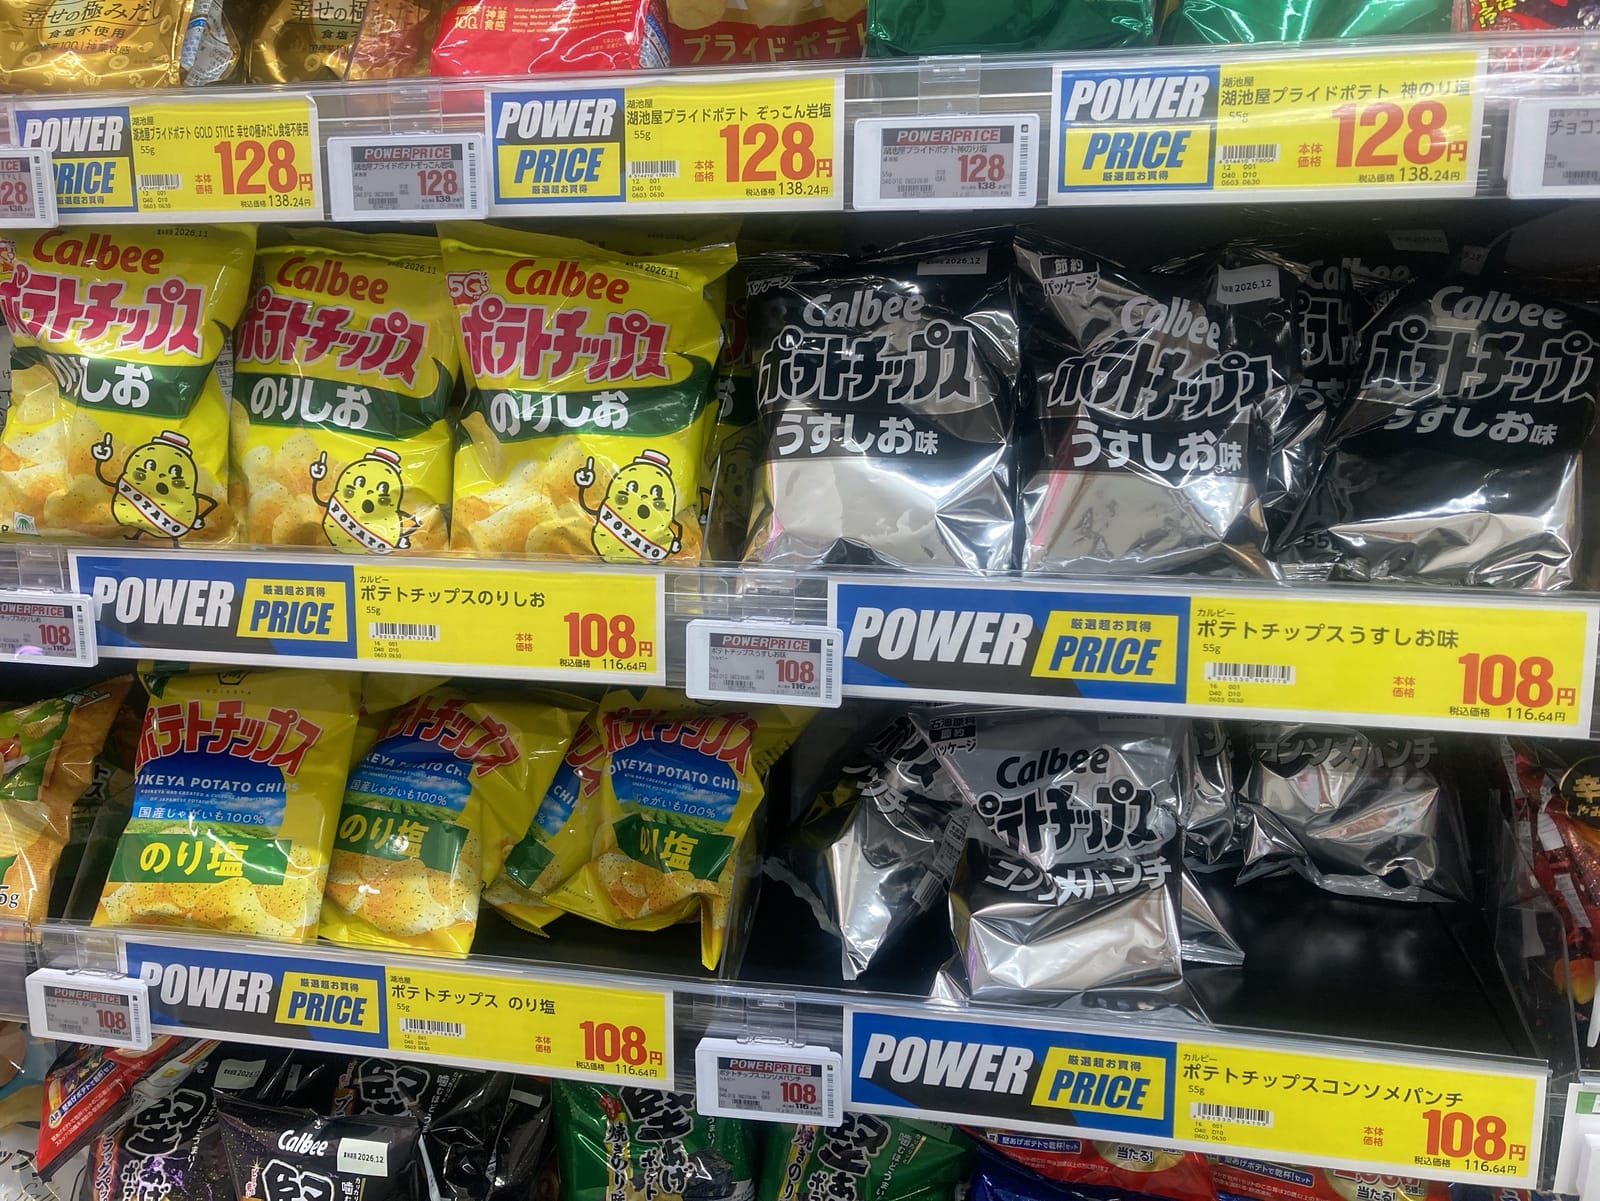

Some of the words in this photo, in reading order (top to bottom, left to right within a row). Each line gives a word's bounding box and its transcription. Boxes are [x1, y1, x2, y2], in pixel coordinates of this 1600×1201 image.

[48, 26, 126, 39] 食塩不使用
[1221, 76, 1254, 88] 湖池屋
[1221, 83, 1389, 107] 湖池屋プライドポテト
[1401, 80, 1471, 99] 神のり塩
[626, 99, 653, 109] 湖池屋
[1064, 75, 1210, 122] POWER
[496, 98, 616, 140] POWER
[626, 107, 749, 126] 湖池屋プライドポテト
[756, 102, 832, 120] ぞっこん岩塩
[1229, 111, 1249, 123] 55g
[24, 115, 124, 153] POWER
[194, 126, 212, 139] GOLD
[216, 125, 235, 138] STYLE
[236, 122, 309, 138] 幸せの極みだし食塩不使用
[634, 129, 651, 141] 55g
[1331, 99, 1468, 168] 128円
[140, 145, 156, 157] 55g
[719, 122, 833, 183] 128円
[1082, 130, 1191, 170] PRICE
[1298, 142, 1323, 155] 本体
[214, 139, 313, 195] 128円
[513, 147, 605, 184] PRICE
[694, 160, 715, 171] 本体
[958, 154, 1005, 182] 128
[1297, 155, 1322, 168] 価格
[53, 161, 117, 195] RICE
[195, 174, 212, 184] 本体
[417, 170, 458, 196] 128
[694, 171, 715, 183] 価格
[1102, 170, 1169, 182] 厳選超お買得
[1358, 173, 1395, 184] 税込価格
[1399, 166, 1460, 183] 138.24円
[195, 184, 213, 195] 価格
[268, 194, 311, 208] 138.24円
[745, 187, 776, 196] 税込価格
[778, 182, 829, 196] 138.24円
[32, 230, 165, 275] Calbee
[1054, 258, 1084, 275] 節約
[276, 256, 389, 305] Calbee
[505, 259, 630, 304] Calbee
[1044, 274, 1099, 297] パッケージ
[1234, 278, 1273, 293] 2026.12
[0, 263, 203, 357] ポテトチップス
[803, 289, 926, 328] Calbee
[1431, 286, 1567, 329] Calbee
[1120, 295, 1221, 350] Calbee
[236, 287, 430, 390] ポテトチップス
[460, 294, 673, 384] ポテトチップス
[757, 318, 978, 408] ポテトチップス
[250, 377, 373, 430] のりしお
[490, 388, 630, 437] のりしお
[776, 413, 939, 456] うすしお味
[1071, 421, 1242, 472] うすしお味
[120, 484, 182, 534] POTATO
[602, 510, 661, 558] POTATO
[359, 576, 389, 584] カルビー
[94, 576, 235, 627] POWER
[361, 585, 545, 608] ポテトチップスのりしお
[250, 600, 335, 635] PRICE
[366, 606, 381, 616] 55g
[1197, 608, 1235, 618] カルビー
[39, 624, 70, 646] 108
[563, 611, 653, 659] 108円
[844, 607, 1034, 666] POWER
[1071, 618, 1152, 633] 厳選超お買得
[1197, 619, 1460, 650] ポテトチップスうすしお味
[515, 633, 533, 643] 本体
[515, 643, 533, 652] 価格
[1202, 643, 1221, 655] 55g
[559, 658, 591, 669] 税込価格
[602, 658, 647, 671] 116.64円
[1048, 635, 1162, 676] PRICE
[776, 659, 814, 684] 108
[1393, 676, 1416, 688] 本体
[1458, 652, 1576, 708] 108円
[1392, 687, 1415, 698] 価格
[1449, 706, 1490, 718] 税込価格
[1506, 707, 1566, 722] 116.64円
[657, 765, 708, 784] POTATO
[997, 748, 1109, 789] Calbee
[190, 777, 251, 793] POTATO
[350, 778, 448, 806] 国産じゃがいも100%
[138, 806, 265, 825] 国産じゃがいも100%
[339, 814, 430, 858] のり塩
[139, 841, 249, 877] のり塩
[140, 962, 274, 1014] POWER
[391, 984, 498, 1009] ポテトチップス
[508, 996, 556, 1015] のり塩
[288, 992, 367, 1026] PRICE
[397, 1002, 410, 1012] 55g
[96, 1009, 126, 1030] 108
[535, 1036, 551, 1045] 本体
[535, 1044, 552, 1053] 価格
[579, 1020, 663, 1066] 108円
[576, 1060, 605, 1072] 税込価格
[615, 1063, 658, 1078] 116.64円
[859, 1033, 1034, 1095] POWER
[1068, 1054, 1141, 1073] 厳選超お買得
[1183, 1053, 1217, 1063] カルビー
[780, 1082, 817, 1104] 108
[1047, 1070, 1151, 1110] PRICE
[1183, 1063, 1464, 1107] ポテトチップスコンソメパンチ
[1188, 1084, 1206, 1097] 55g
[278, 1129, 330, 1156] Calbee
[1363, 1126, 1384, 1136] 本体
[1363, 1136, 1384, 1147] 価格
[1422, 1108, 1527, 1162] 108円
[1117, 1146, 1154, 1163] 当たる!
[1414, 1155, 1451, 1168] 税込価格
[1464, 1158, 1517, 1175] 116.64円
